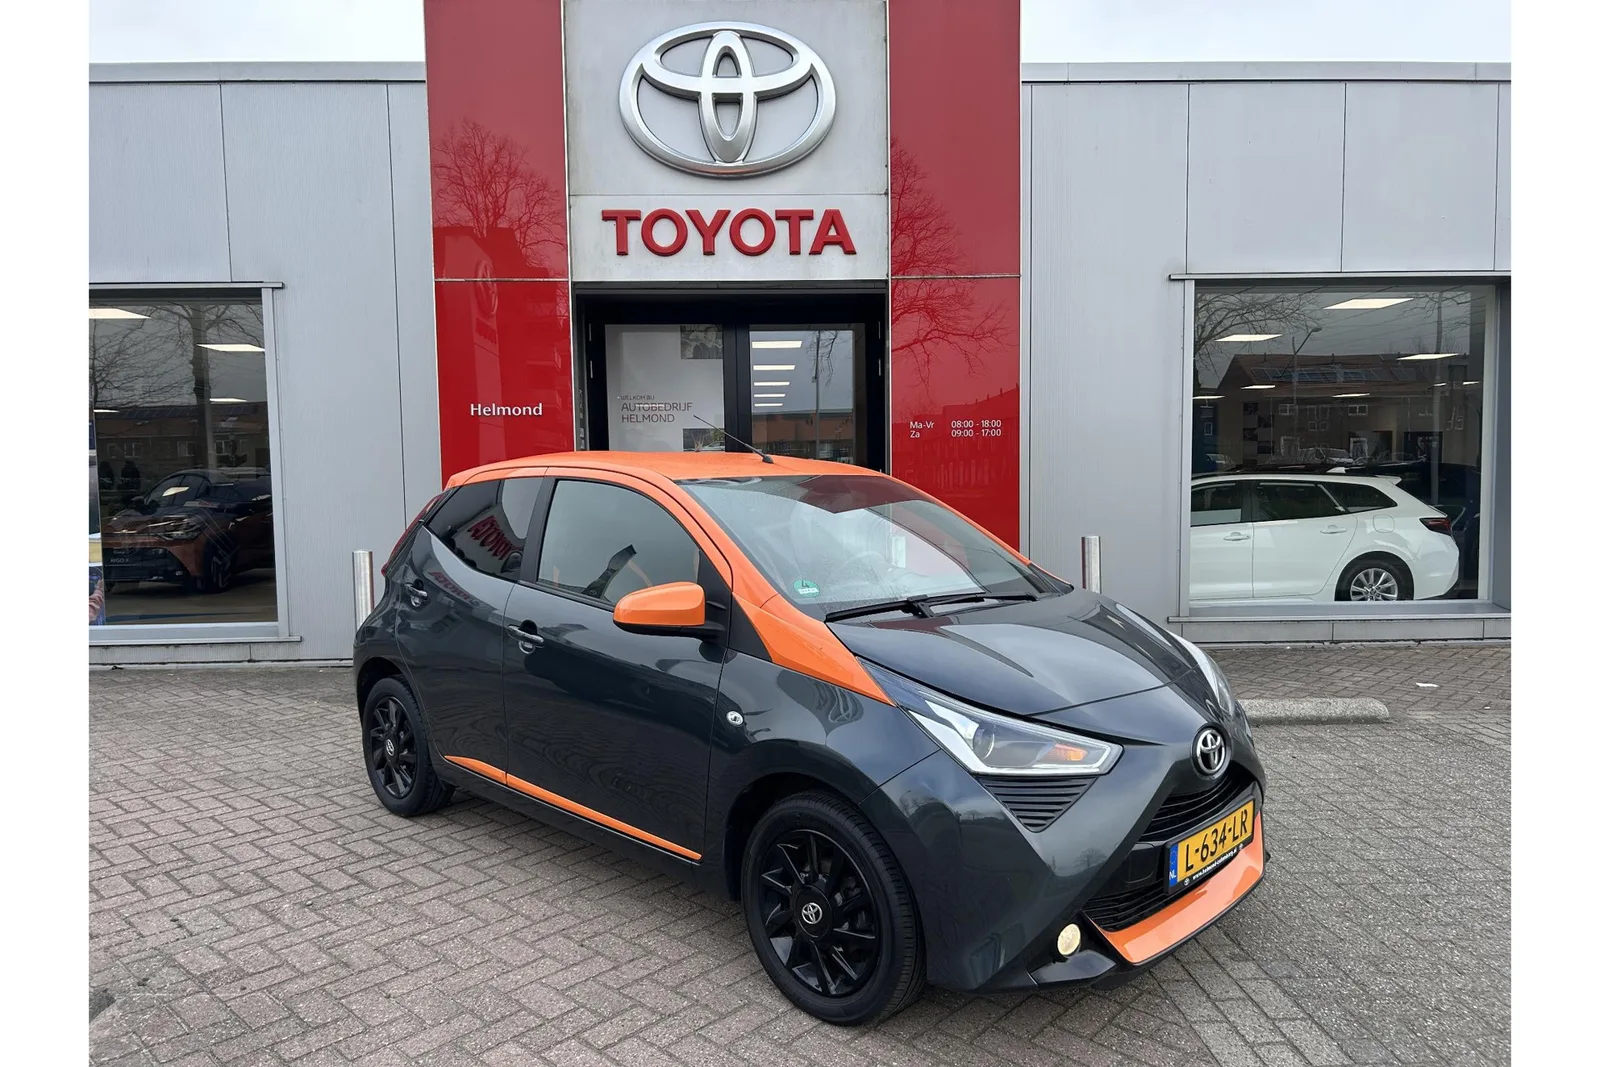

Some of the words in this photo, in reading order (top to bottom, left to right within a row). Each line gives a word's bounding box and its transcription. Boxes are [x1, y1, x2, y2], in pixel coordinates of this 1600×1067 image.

[601, 208, 857, 257] TOYOTA
[470, 402, 543, 416] Helmond
[620, 402, 693, 412] AUTOBEDRIJF
[621, 413, 675, 423] HELMOND
[909, 421, 935, 429] Ma-Vr
[951, 420, 974, 428] 08:00
[981, 420, 1002, 428] 18:00
[910, 430, 921, 438] Za
[951, 429, 974, 437] 09:00
[981, 429, 1002, 437] 17:00
[1185, 808, 1248, 873] L-634-LR
[1169, 869, 1177, 879] NL
